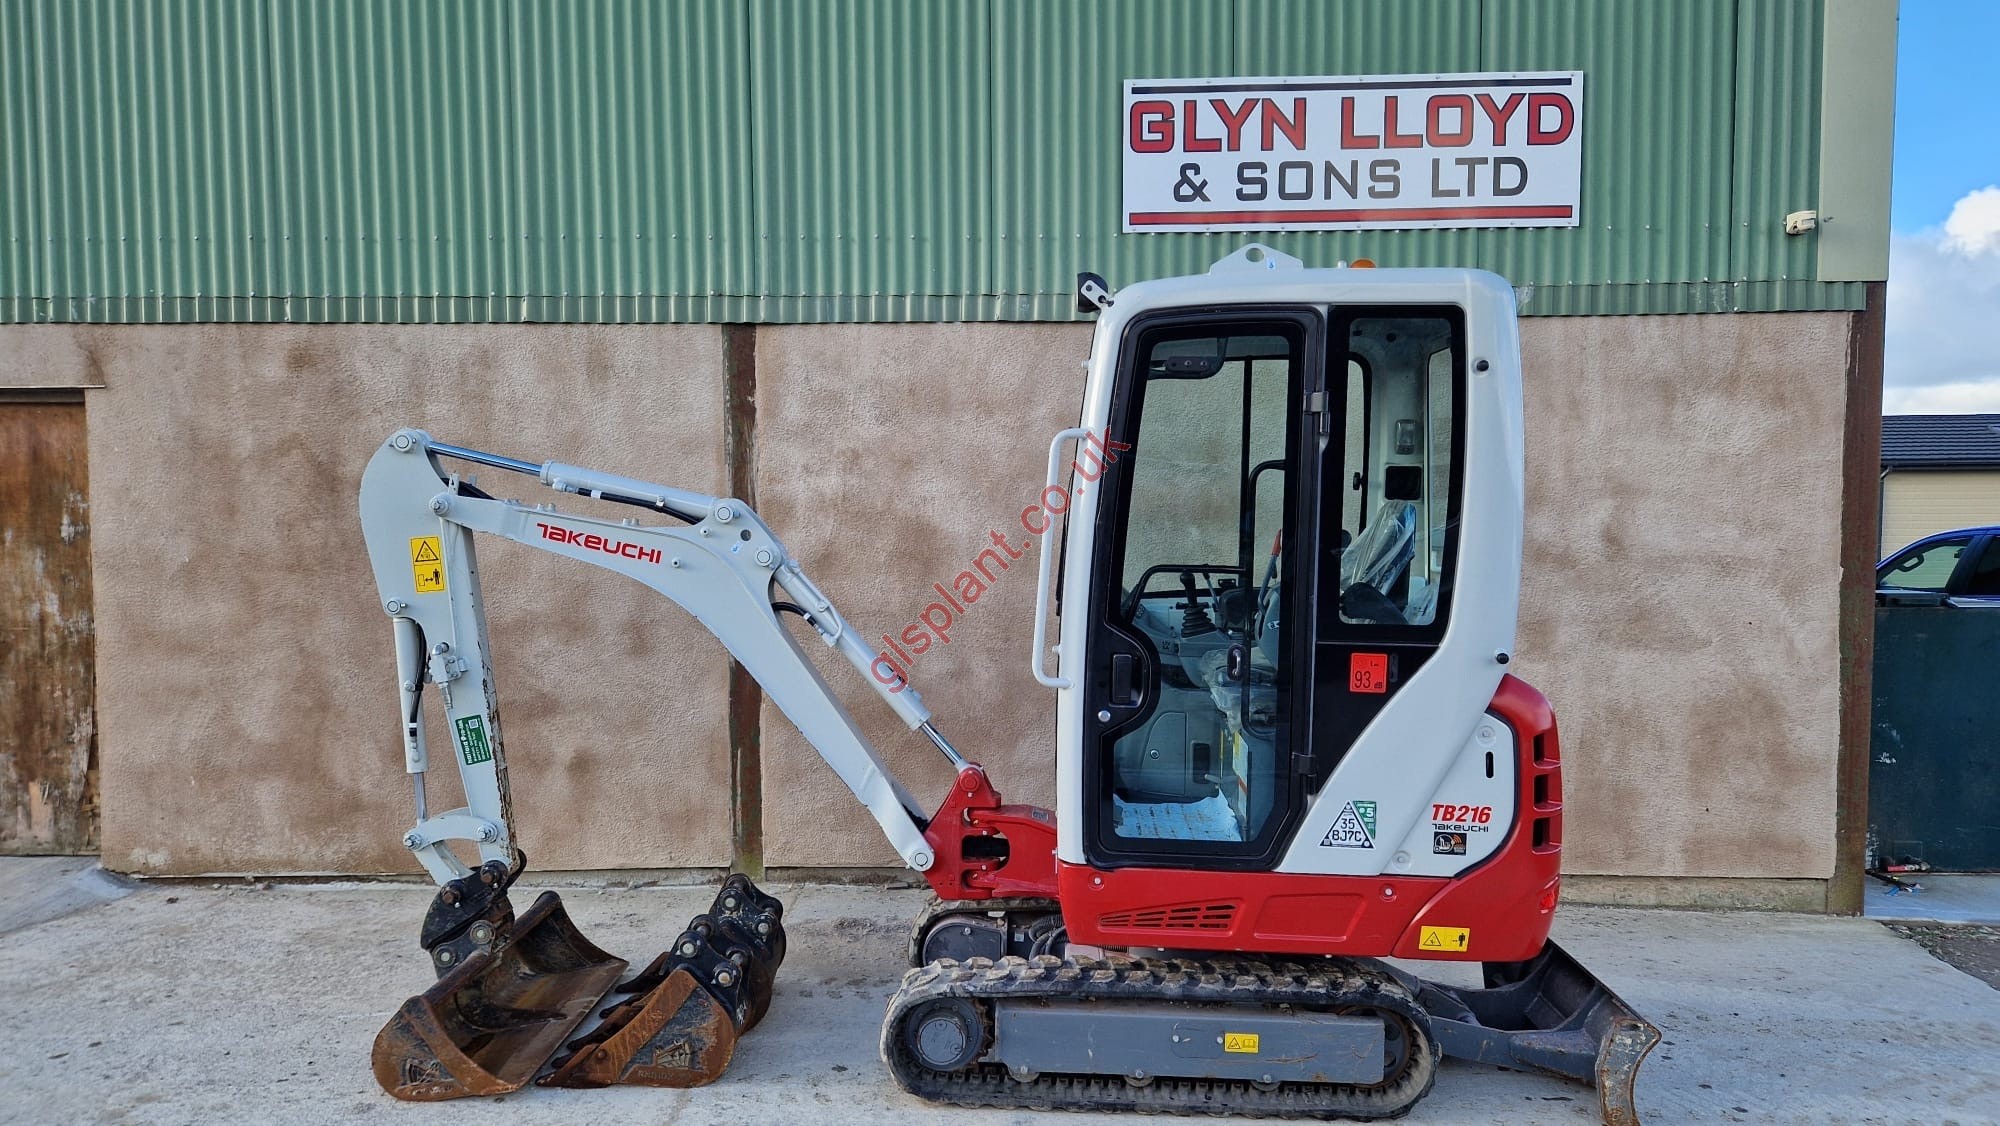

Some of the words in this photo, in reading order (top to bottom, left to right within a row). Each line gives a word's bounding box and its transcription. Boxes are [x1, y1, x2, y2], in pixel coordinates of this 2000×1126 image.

[1130, 97, 1307, 153] GLYN
[1340, 92, 1575, 149] LLOYD
[1173, 162, 1211, 202] &
[1236, 158, 1402, 201] SONS
[1431, 156, 1529, 198] LTD
[537, 522, 662, 564] TAKEUCHI
[1354, 670, 1371, 689] 93
[1340, 817, 1355, 830] 35
[1432, 804, 1492, 824] TB216
[1332, 829, 1362, 842] BJ7C
[1431, 823, 1489, 833] TAKEUCHI
